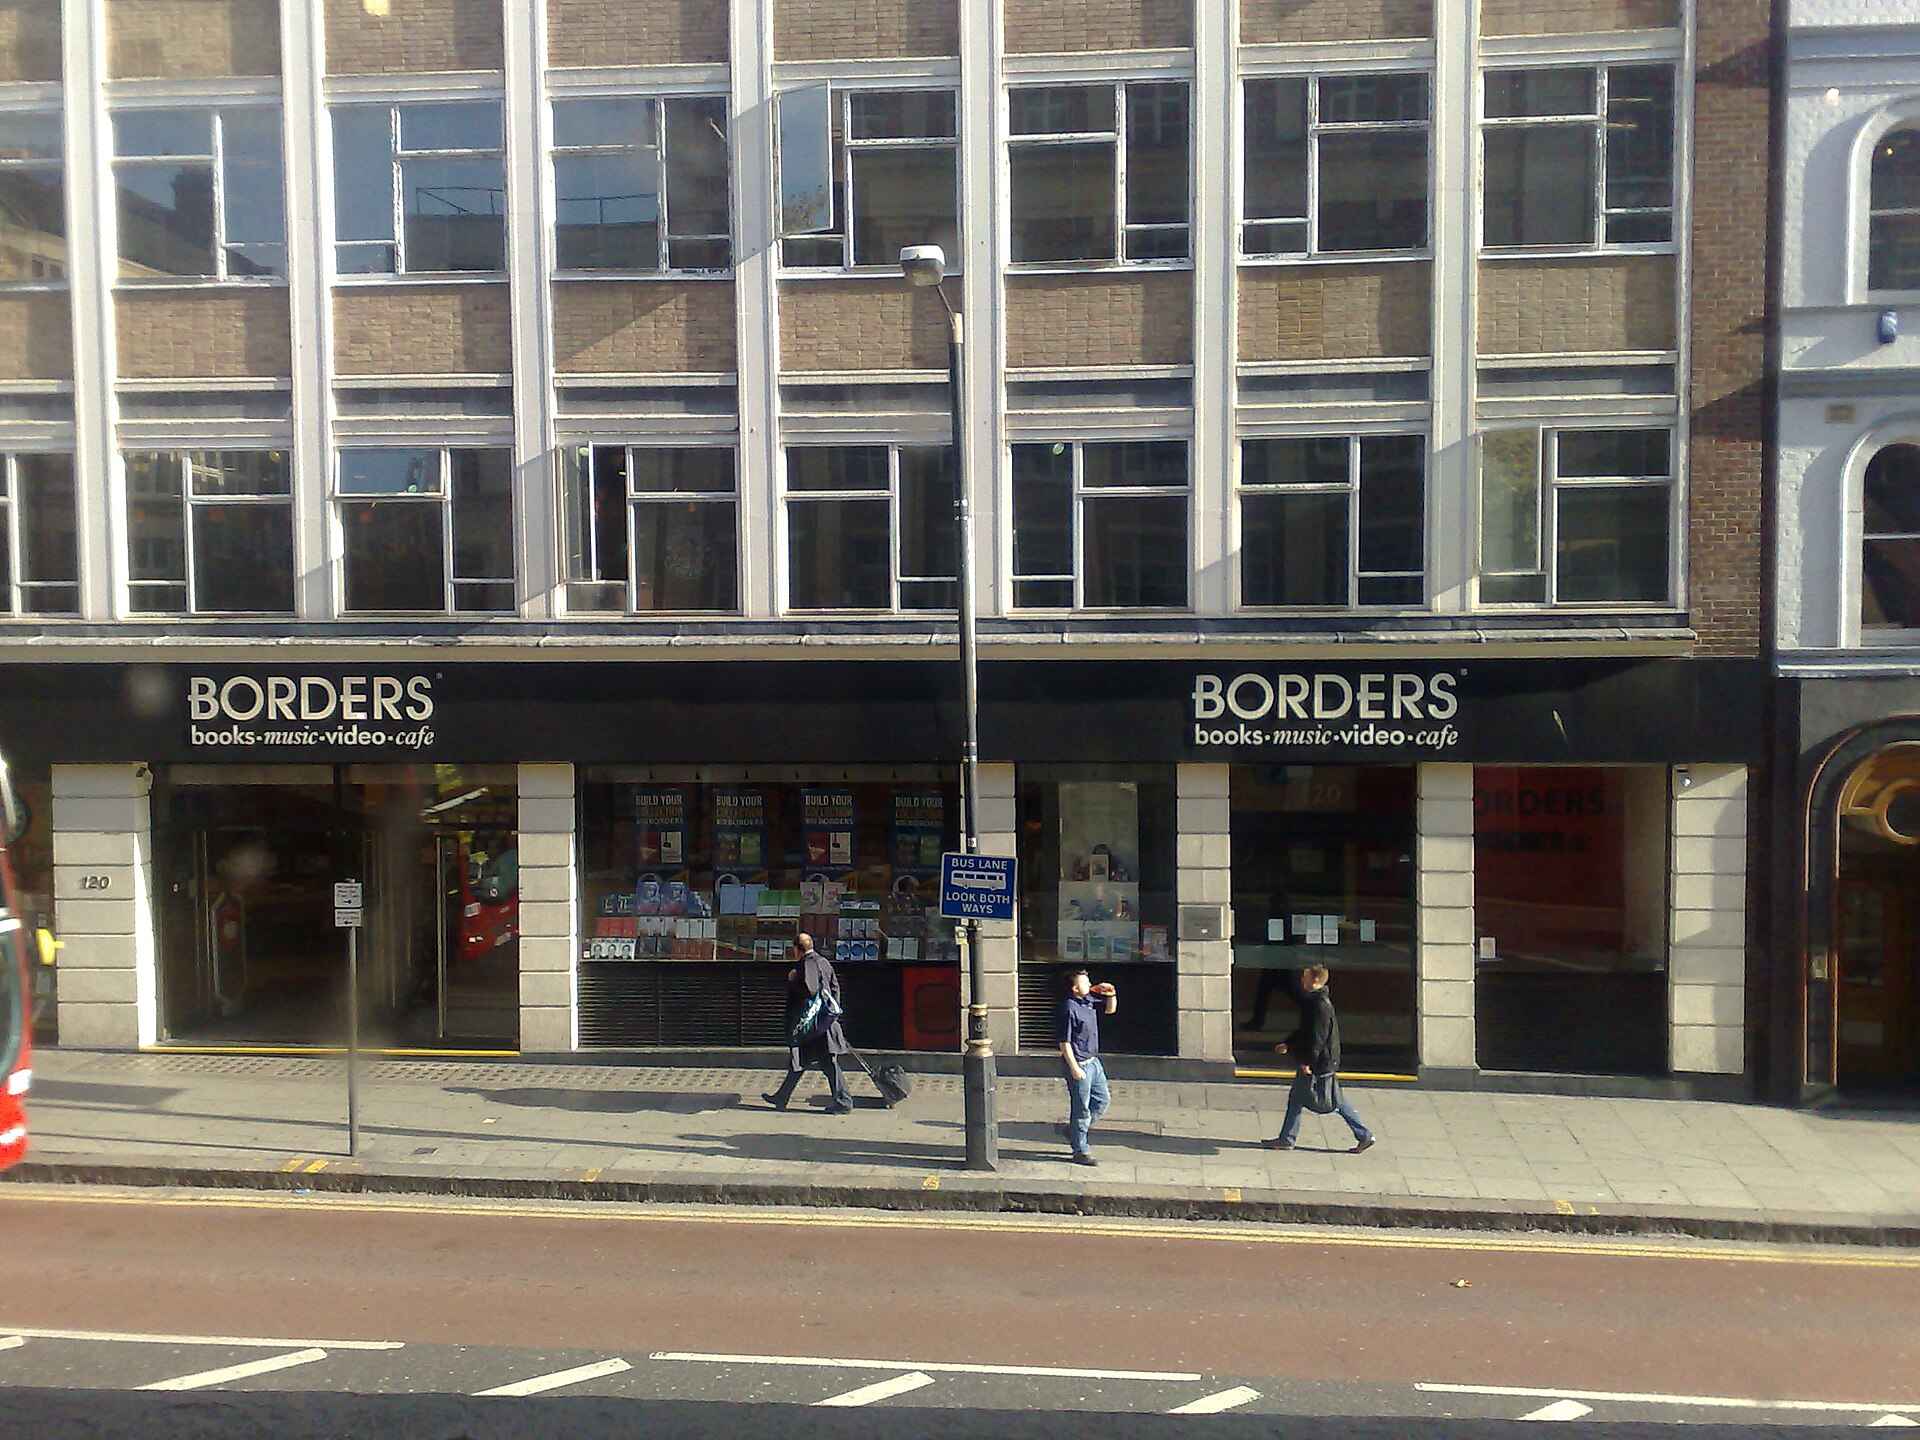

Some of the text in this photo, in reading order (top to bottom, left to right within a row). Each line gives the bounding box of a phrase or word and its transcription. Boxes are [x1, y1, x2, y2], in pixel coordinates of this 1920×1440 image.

[188, 675, 433, 721] BORDERS
[1192, 673, 1458, 720] BORDERS
[191, 725, 435, 749] books music video cafe
[1195, 723, 1458, 750] books music video cafe
[635, 794, 683, 806] BUILD YOUR
[716, 795, 763, 807] BUILD YOUR
[805, 794, 853, 806] BUILD YOUR
[895, 796, 944, 808] BUILD YOUR
[1475, 788, 1606, 817] ORDERS
[951, 858, 1008, 870] BUS LANE
[81, 875, 110, 890] 120
[946, 892, 1010, 904] LOOK BOTH
[962, 903, 994, 914] WAYS
